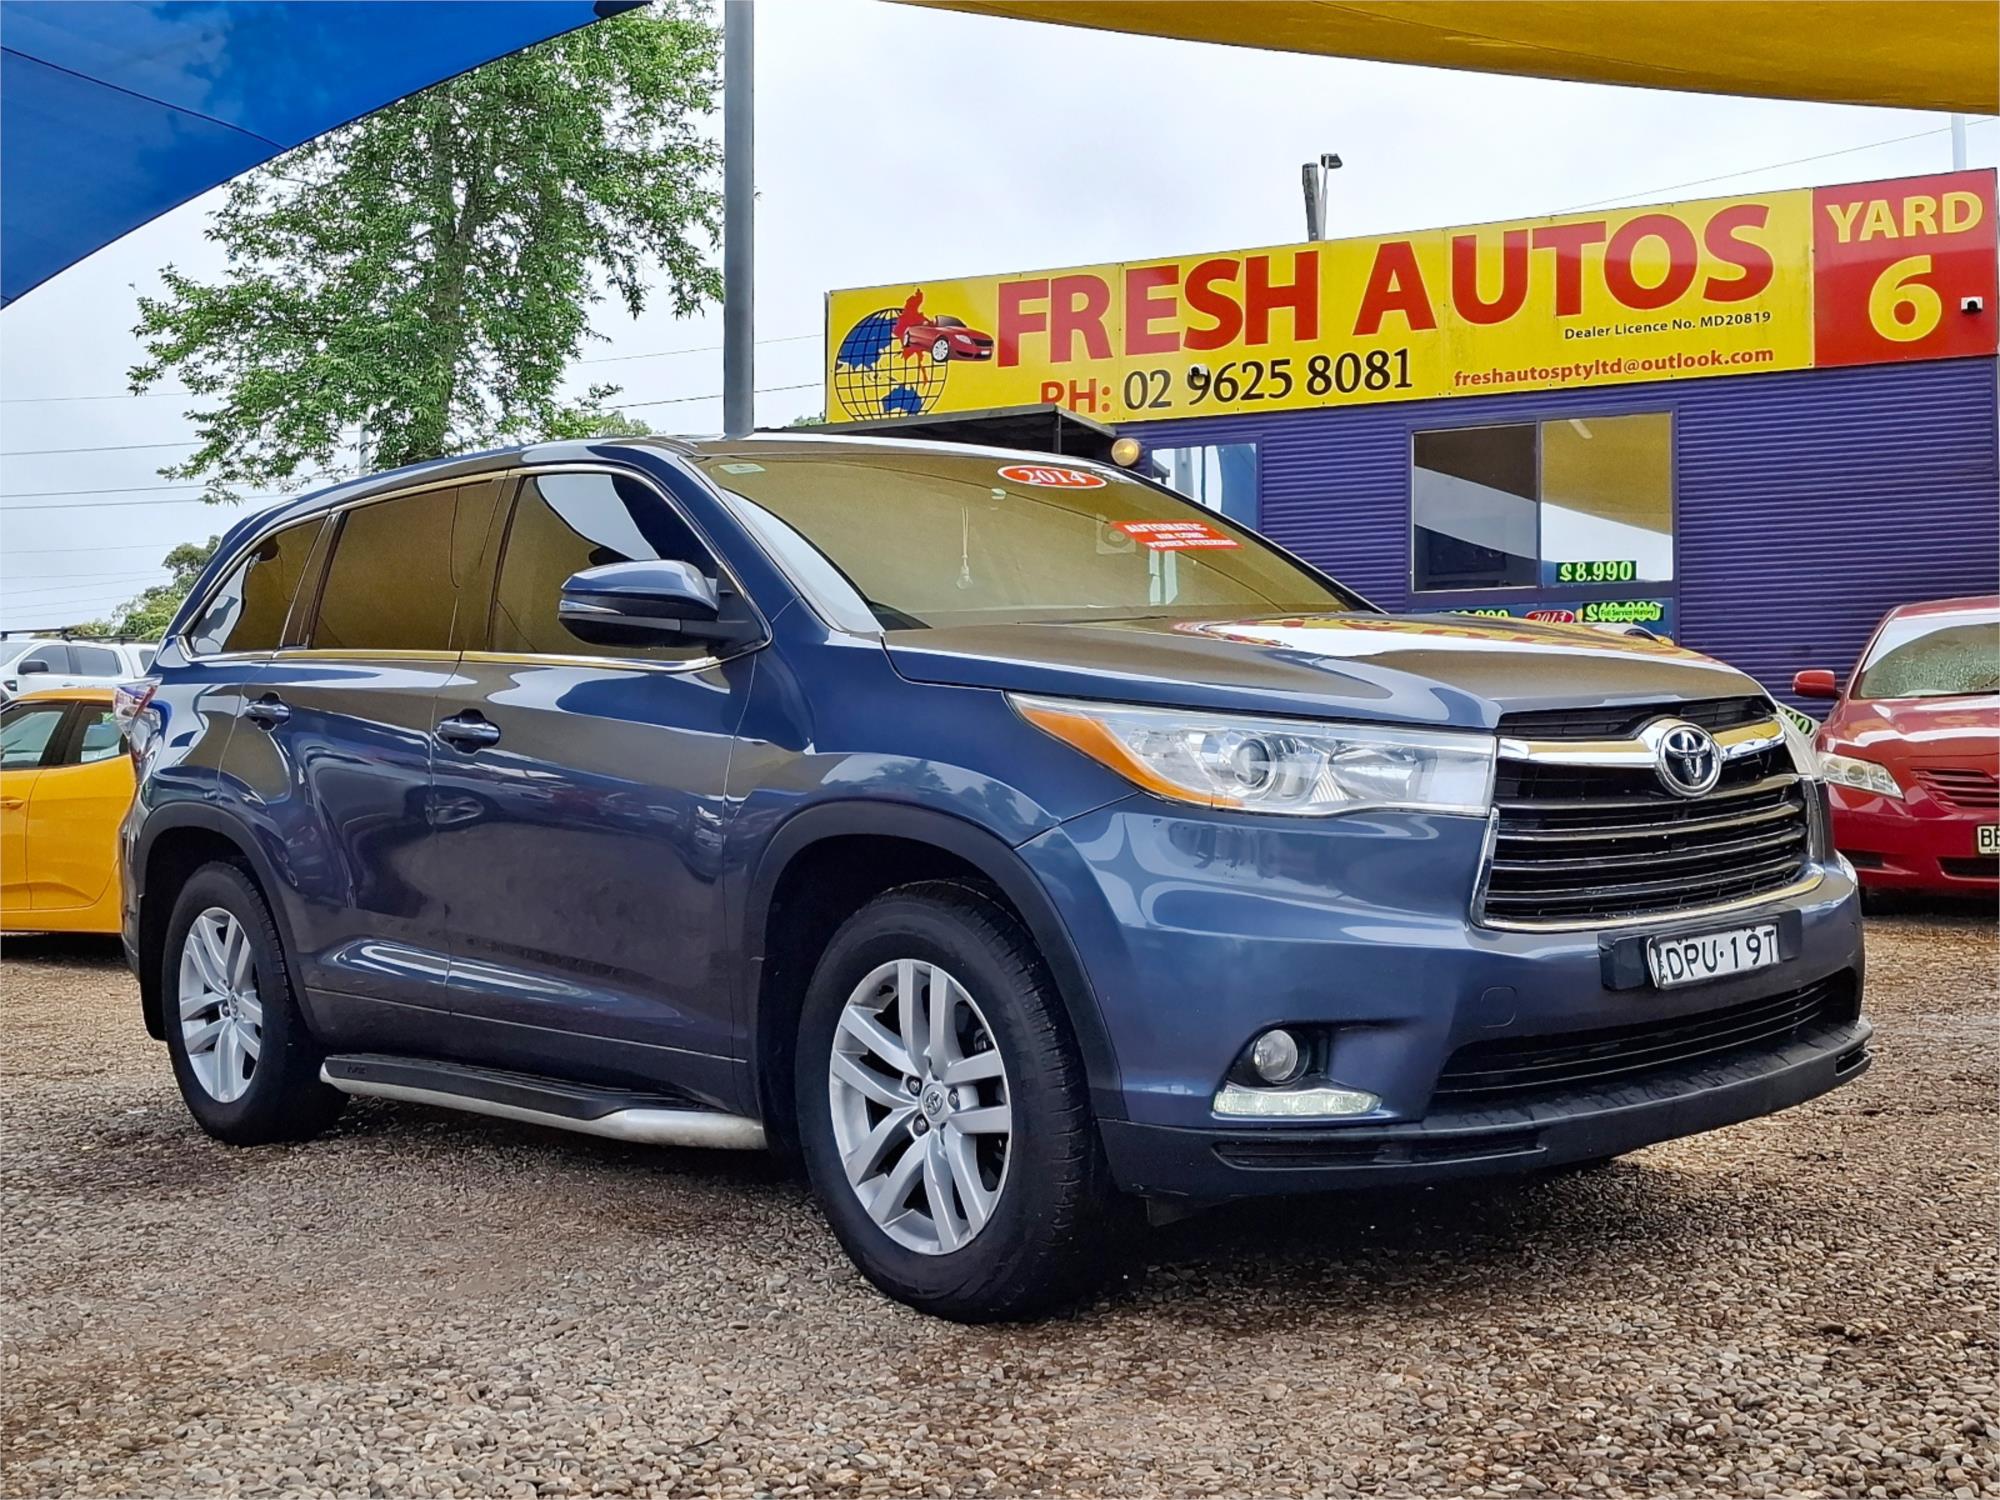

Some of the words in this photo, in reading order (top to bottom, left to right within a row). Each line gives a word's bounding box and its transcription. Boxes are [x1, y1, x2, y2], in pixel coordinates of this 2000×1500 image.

[1826, 191, 1984, 244] YARD
[997, 250, 1320, 368] FRESH
[1353, 204, 1775, 336] AUTOS
[1868, 255, 1943, 342] 6
[1564, 326, 1611, 340] Dealer
[1614, 322, 1668, 336] Licence
[1672, 319, 1696, 331] No.
[1700, 311, 1771, 328] MD20819
[1041, 378, 1111, 413] PH:
[1123, 370, 1173, 410] 02
[1187, 358, 1293, 405] 9625
[1306, 347, 1413, 395] 8081
[1454, 348, 1774, 387] freshautosptyltd@outlook.com
[1017, 469, 1087, 485] 2014
